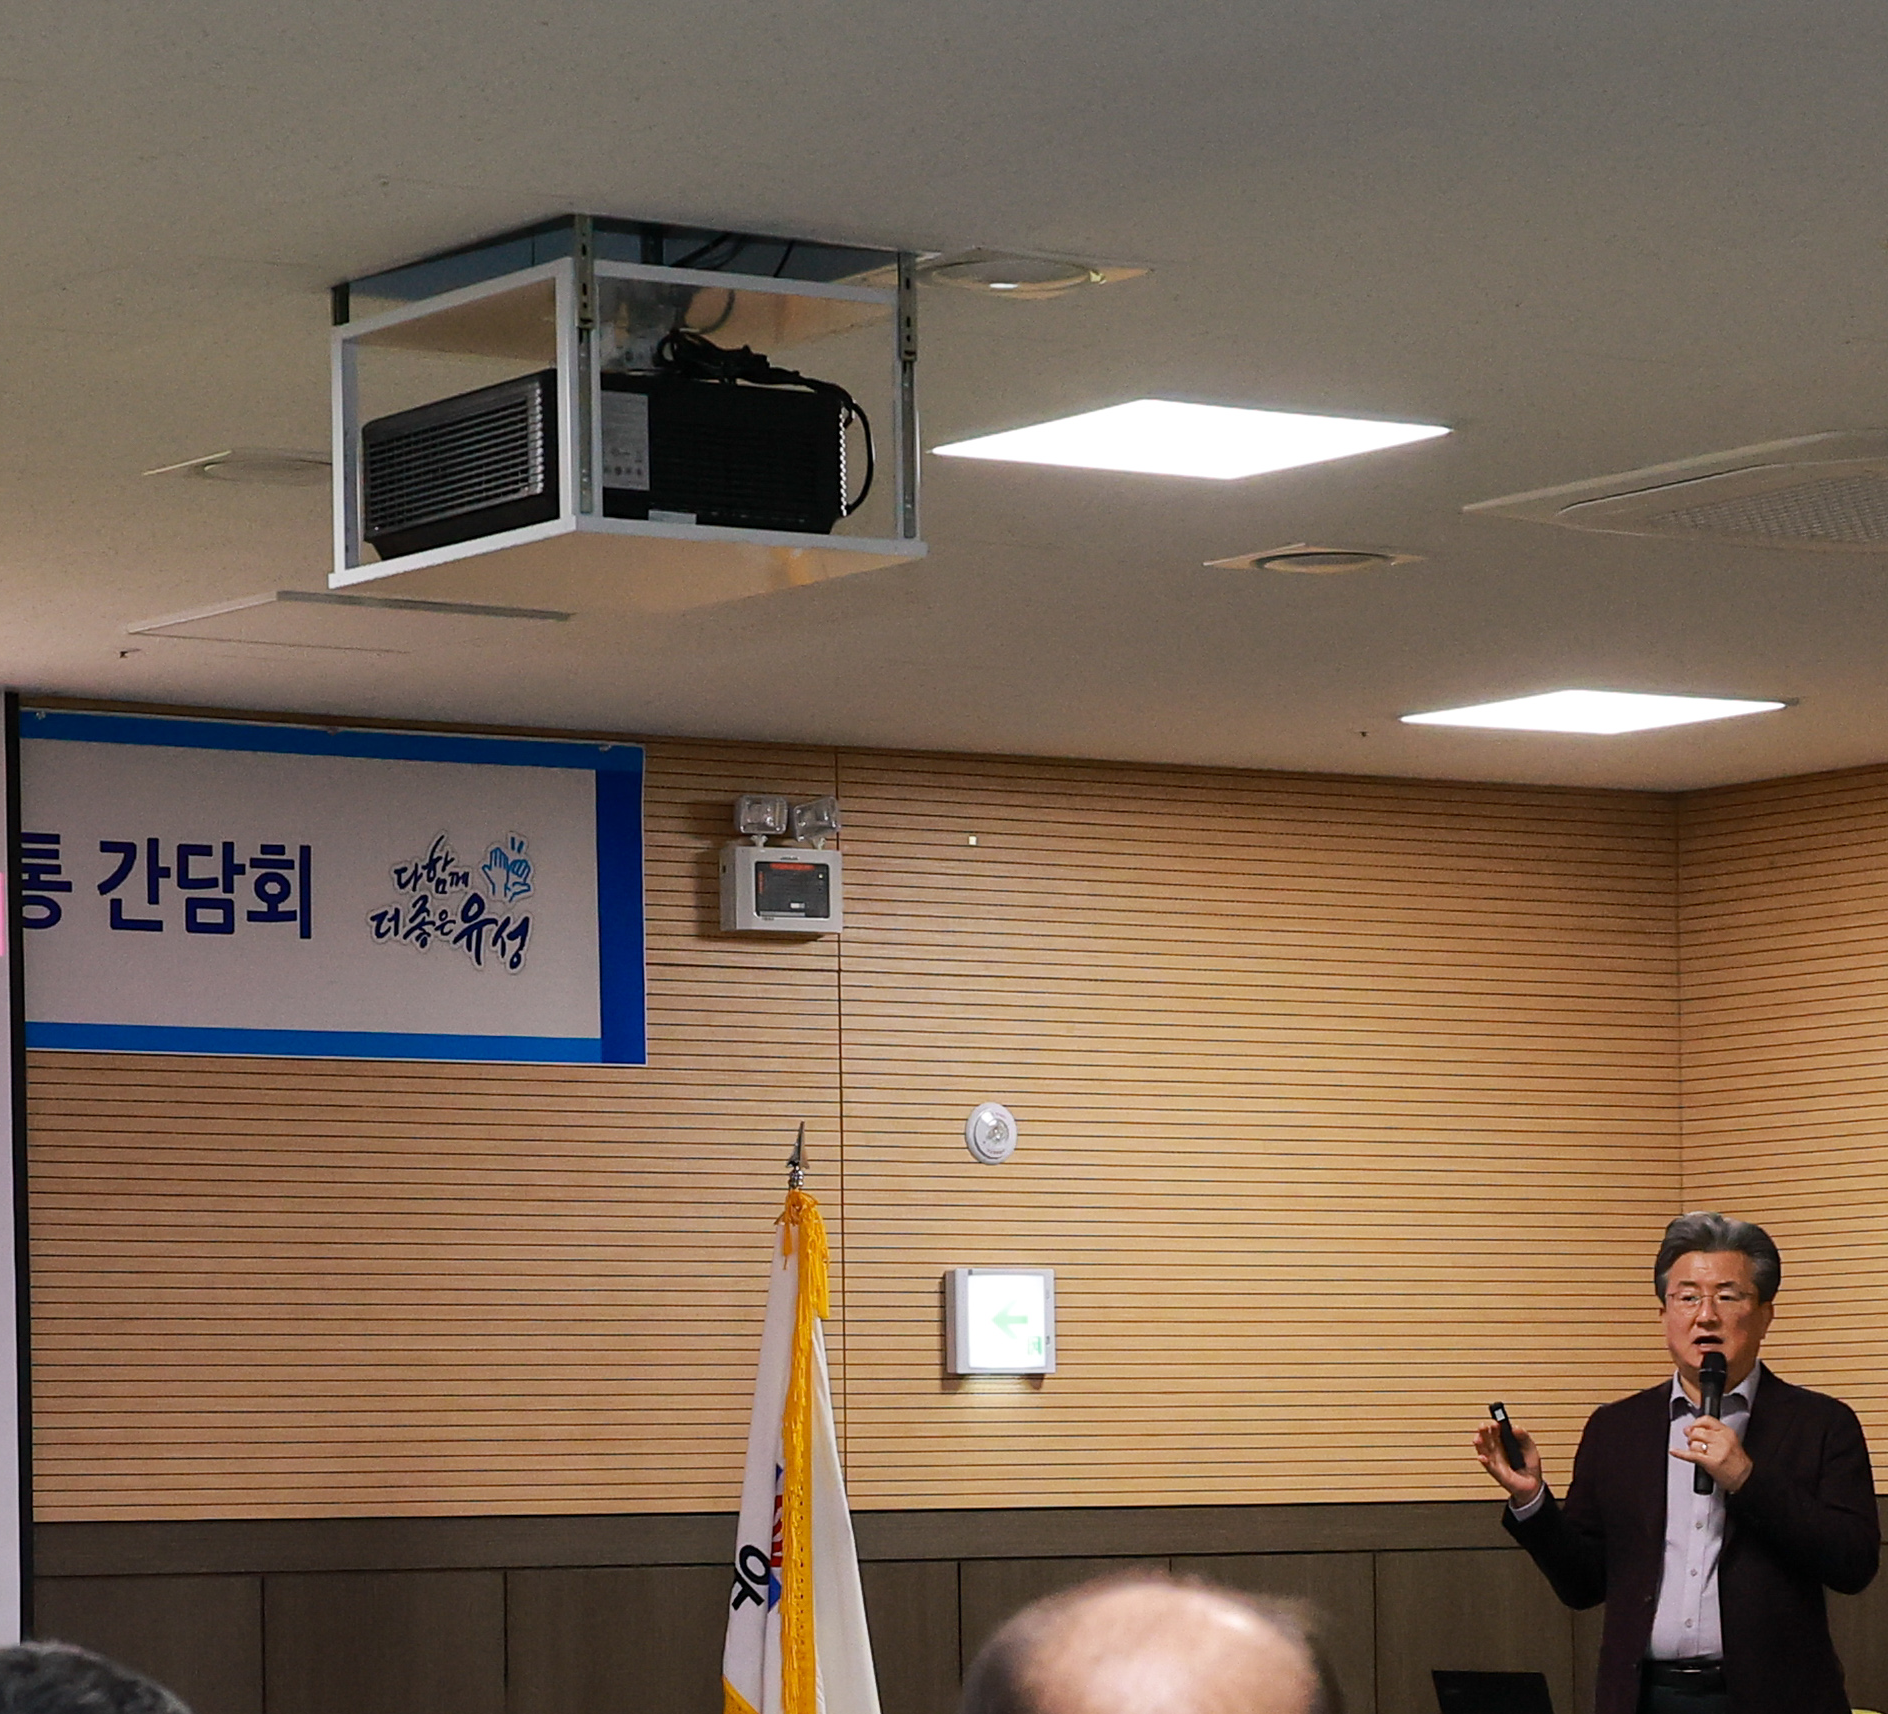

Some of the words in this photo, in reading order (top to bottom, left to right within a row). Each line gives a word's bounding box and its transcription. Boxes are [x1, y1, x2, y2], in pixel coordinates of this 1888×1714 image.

[97, 836, 312, 939] 간담회
[394, 834, 470, 895] 다함께
[370, 907, 401, 939] 더
[403, 894, 457, 949] 좋은
[452, 892, 530, 970] 유성
